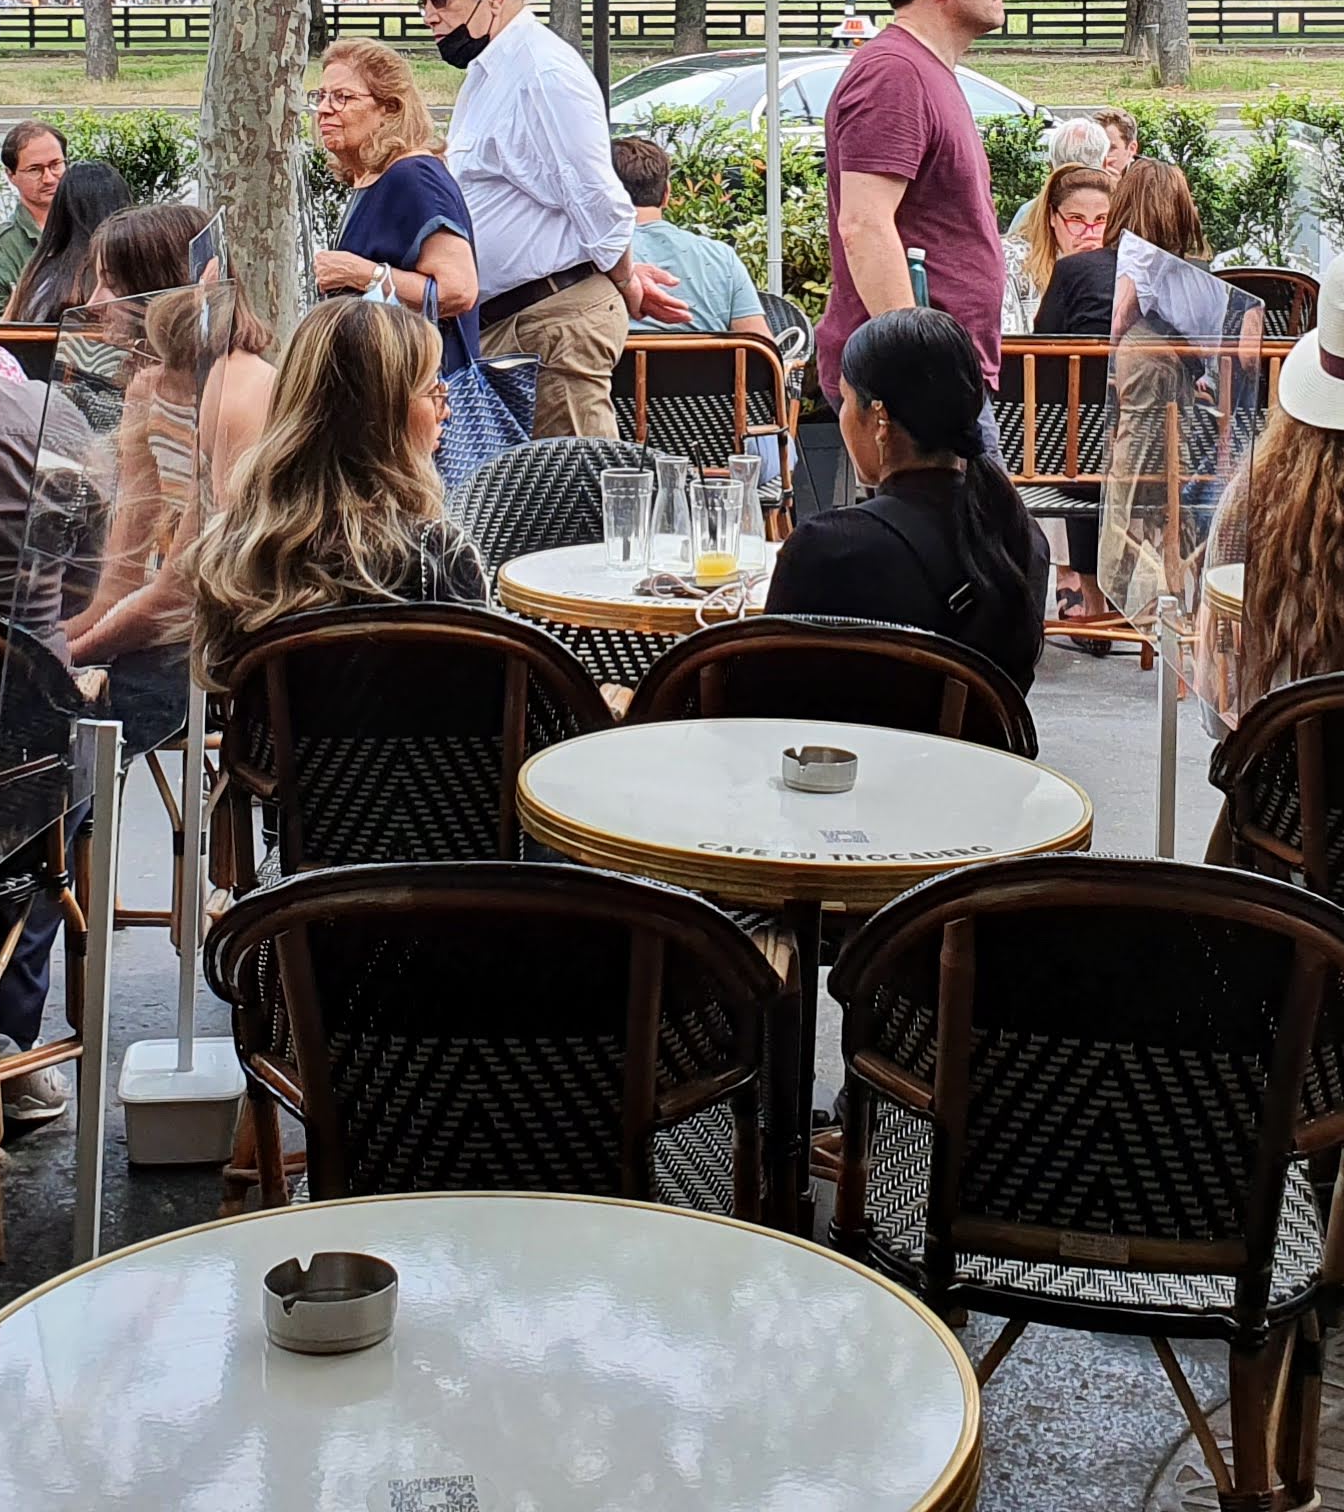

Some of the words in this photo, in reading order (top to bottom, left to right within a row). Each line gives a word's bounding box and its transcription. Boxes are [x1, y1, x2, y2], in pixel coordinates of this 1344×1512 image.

[697, 842, 770, 857] CAFE
[780, 851, 817, 860] DU
[827, 844, 994, 861] TROCADERO
